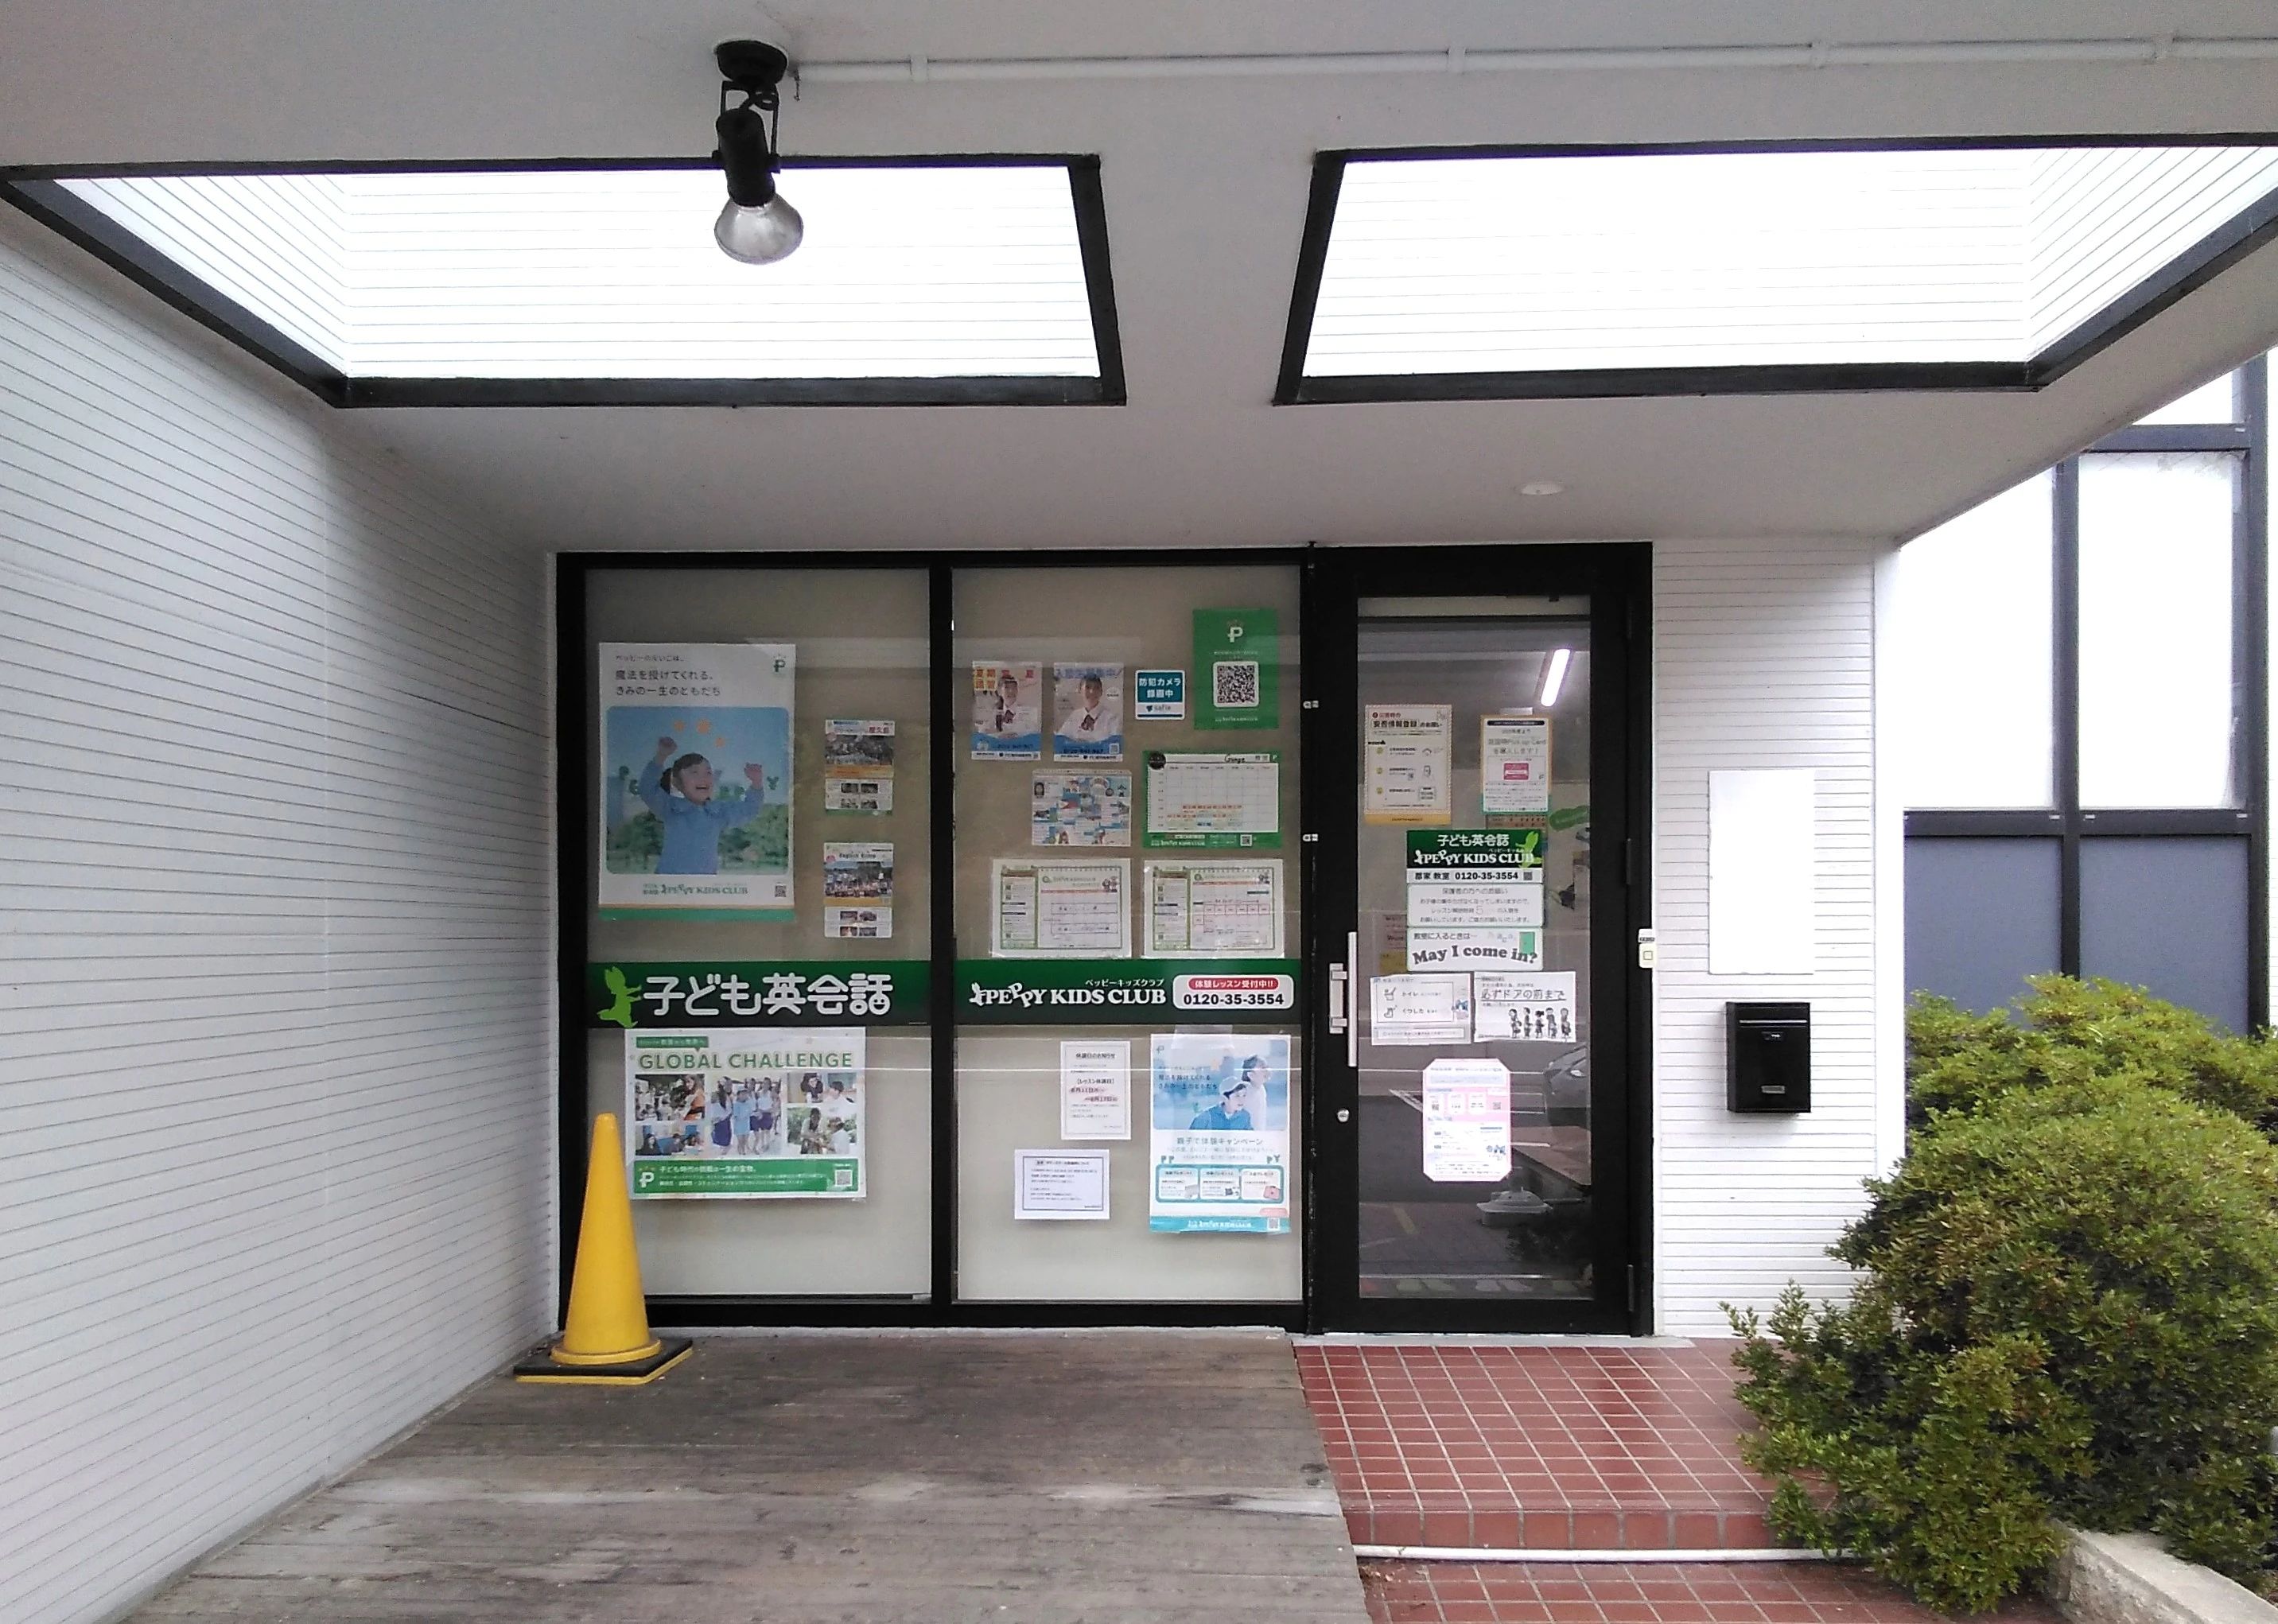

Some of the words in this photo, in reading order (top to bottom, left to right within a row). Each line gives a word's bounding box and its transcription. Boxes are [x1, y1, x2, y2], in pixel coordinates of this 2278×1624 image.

[1139, 678, 1182, 686] 防犯カメラ
[616, 686, 721, 696] きみの一生のともだち
[1147, 690, 1174, 698] 録画中
[1437, 833, 1510, 847] 子ども英会話
[1421, 849, 1461, 865] PEPPY
[1464, 853, 1497, 864] KIDS
[1455, 872, 1518, 880] 0120-35-3554
[722, 886, 748, 895] CLUB
[1412, 949, 1448, 965] May
[1452, 945, 1459, 958] I
[1463, 946, 1507, 958] come
[1511, 948, 1538, 964] in?
[1085, 978, 1165, 988] ペッピーキッズクラブ
[1195, 979, 1273, 989] 体験レッスン受付中!!
[643, 972, 893, 1016] 子ども英会話
[985, 982, 1048, 1008] PEPPY
[1050, 989, 1105, 1004] KIDS
[1107, 989, 1167, 1004] CLUB
[1184, 993, 1285, 1005] 0120-35-3554
[1482, 989, 1565, 1000] 必ずドアの前まで
[639, 1053, 722, 1070] GLOBAL
[729, 1052, 853, 1069] CHALLENGE
